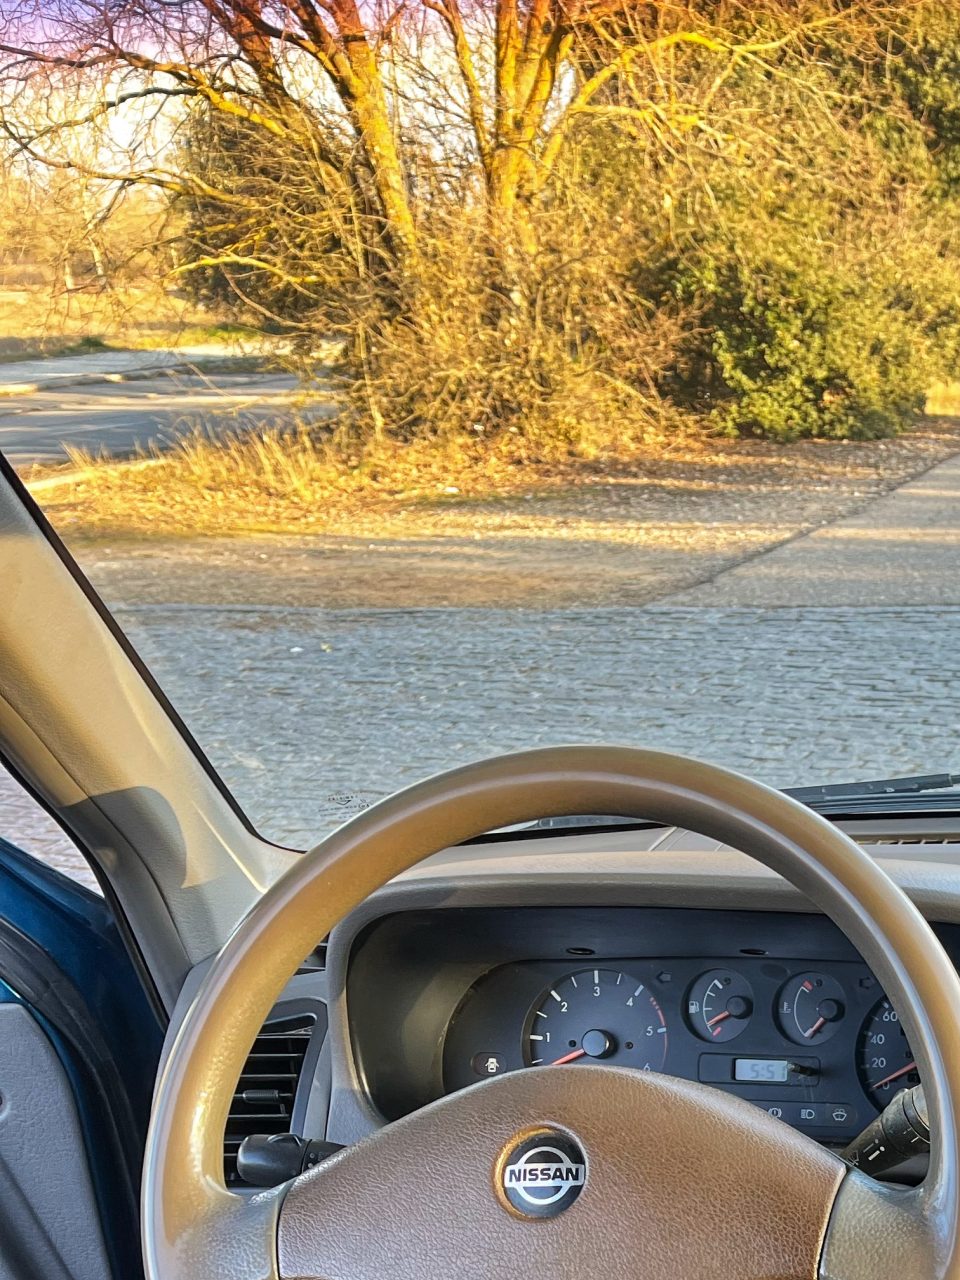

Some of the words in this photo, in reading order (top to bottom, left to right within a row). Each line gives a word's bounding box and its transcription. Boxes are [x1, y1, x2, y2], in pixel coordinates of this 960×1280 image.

[593, 986, 601, 997] 3
[561, 1001, 568, 1012] 2
[626, 997, 634, 1007] 4
[882, 1011, 898, 1022] 60
[646, 1026, 653, 1036] 5
[546, 1032, 551, 1042] 1
[870, 1033, 885, 1045] 40
[872, 1057, 887, 1068] 20
[508, 1167, 580, 1183] NISSAN
